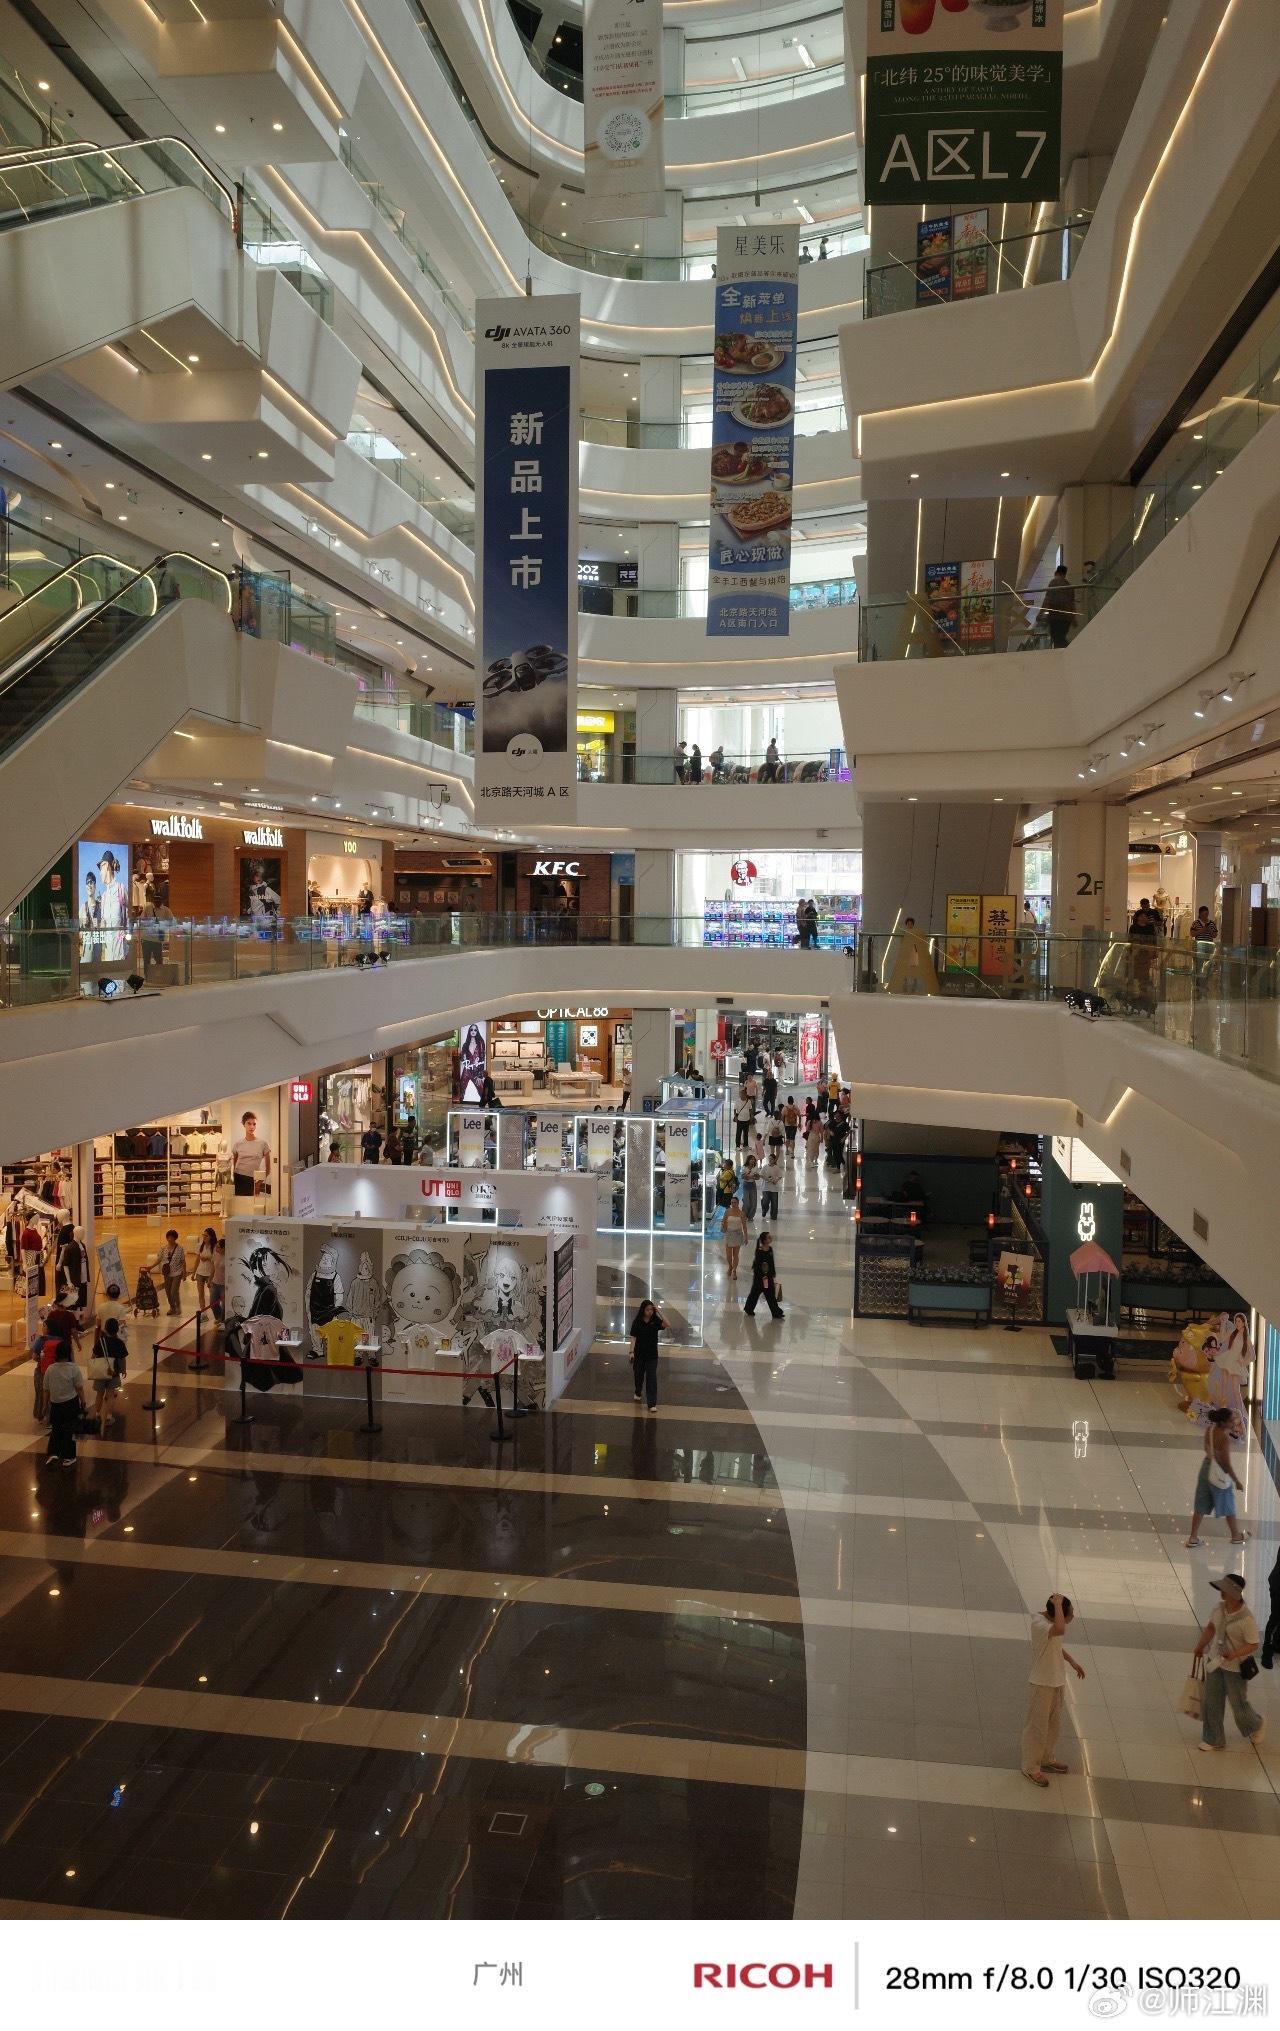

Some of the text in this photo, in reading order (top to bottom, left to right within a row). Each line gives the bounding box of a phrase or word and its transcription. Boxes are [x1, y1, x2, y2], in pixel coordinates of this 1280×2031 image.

[735, 235, 785, 257] 星美乐
[721, 286, 785, 309] 全新菜单
[513, 326, 547, 337] AVATA
[549, 325, 571, 336] 360
[509, 411, 544, 590] 新品上市
[720, 545, 785, 566] 匠心现做
[712, 574, 787, 587] 全手工西餐与烘焙
[719, 607, 778, 618] 北京路天河城
[719, 618, 779, 629] A区南门入口
[480, 786, 570, 798] 北京路天河城 A 区
[150, 814, 203, 840] walkfolk
[243, 826, 284, 848] walkfolk
[533, 861, 580, 876] KFC
[1076, 872, 1104, 896] 2F
[537, 1007, 592, 1019] OPTICAL
[293, 1084, 308, 1093] UNI
[293, 1093, 309, 1102] QLO
[463, 1118, 482, 1130] Lee
[540, 1121, 559, 1133] Lee
[591, 1123, 610, 1135] Lee
[669, 1126, 688, 1137] Lee
[421, 1179, 443, 1197] UT
[446, 1189, 460, 1197] QLO
